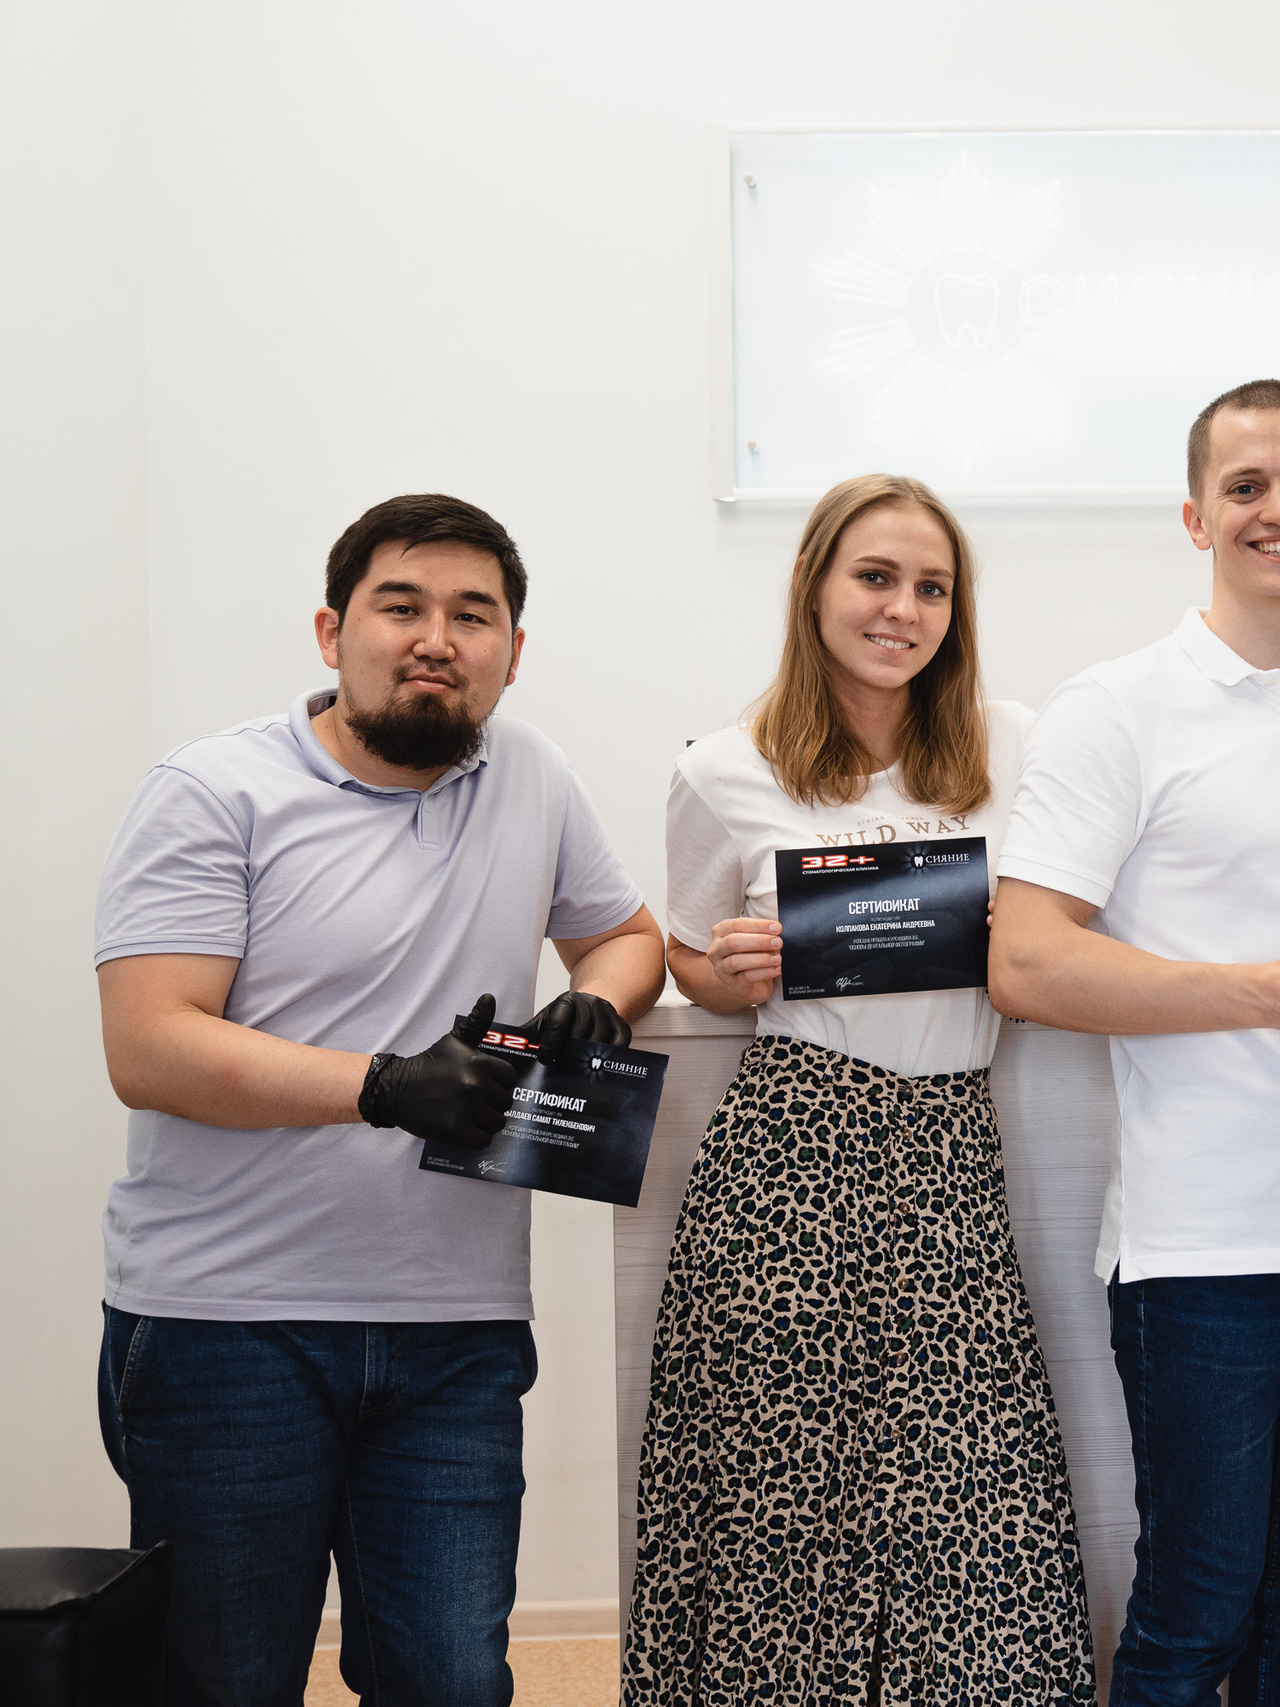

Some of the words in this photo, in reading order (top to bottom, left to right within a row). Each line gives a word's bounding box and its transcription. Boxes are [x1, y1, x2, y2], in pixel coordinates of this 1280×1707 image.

[816, 824, 897, 847] WILD
[906, 814, 970, 834] WAY
[802, 854, 875, 869] 32+
[925, 853, 970, 864] СИЯНИЕ
[802, 866, 856, 875] СТОМАТОЛОГИЧЕСКАЯ
[848, 898, 920, 914] СЕРТИФИКАТ
[835, 924, 869, 933] КОЛПАКОВА
[870, 922, 901, 931] ЕКАТЕРИНА
[902, 919, 935, 928] АНДРЕЕВНА
[603, 1060, 648, 1076] СИЯНИЕ
[512, 1087, 587, 1112] СЕРТИФИКАТ
[532, 1114, 552, 1124] САМАТ
[553, 1117, 596, 1132] ТИЛЕКБЕКОВИЧ
